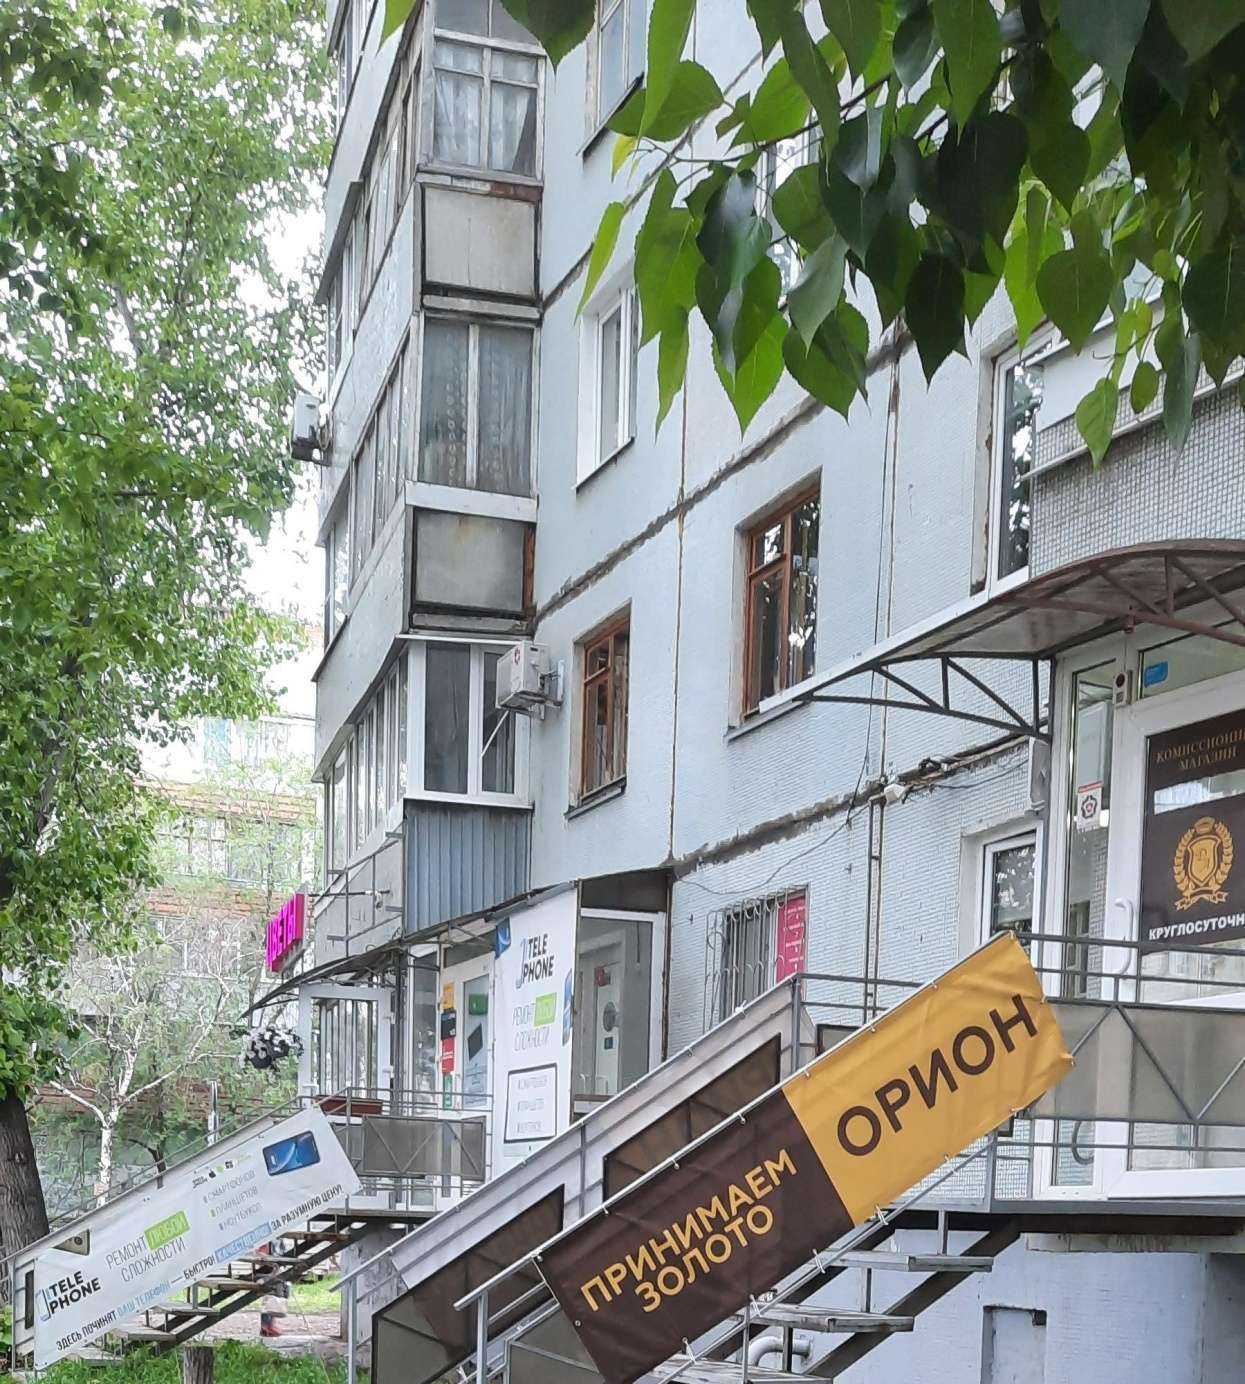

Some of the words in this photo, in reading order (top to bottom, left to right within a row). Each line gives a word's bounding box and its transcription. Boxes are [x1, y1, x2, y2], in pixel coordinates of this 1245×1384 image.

[1178, 746, 1237, 769] МАГАЗИН
[528, 933, 548, 959] TELE
[523, 955, 554, 983] PHONE
[837, 994, 1039, 1157] ОРИОН
[580, 1149, 798, 1313] ПРИНИМАЕМ
[56, 1330, 83, 1351] ЗДЕСЬ
[82, 1310, 117, 1336] ПОЧИНЯТ
[183, 1255, 215, 1279] БЫСТРО!
[271, 1217, 282, 1231] ЗА
[281, 1198, 322, 1227] РАЗУМНУЮ
[321, 1184, 343, 1204] ЦЕНУ!
[106, 1236, 147, 1269] РЕМОНТ
[121, 1237, 187, 1282] СЛОЖНОСТИ
[635, 1204, 774, 1313] ЗОЛОТО
[49, 1278, 101, 1314] PHONE
[50, 1271, 84, 1298] TELE
